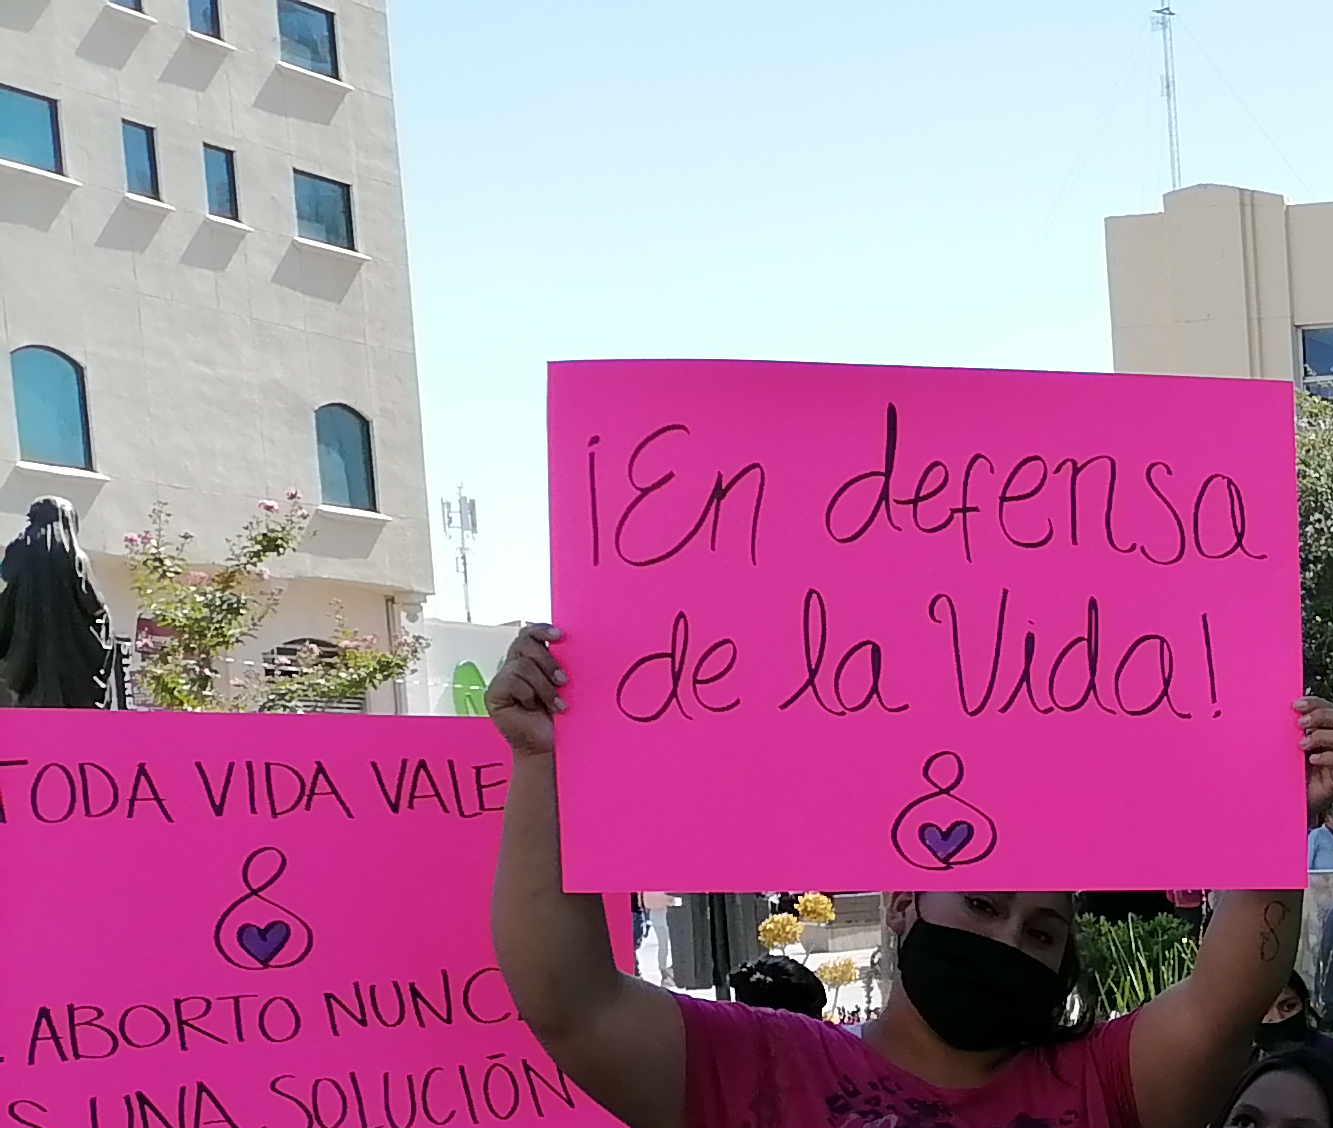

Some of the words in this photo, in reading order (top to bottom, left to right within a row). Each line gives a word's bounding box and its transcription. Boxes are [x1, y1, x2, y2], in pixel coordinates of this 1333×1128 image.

[589, 423, 766, 567] ¡En
[824, 401, 1268, 566] defensa
[616, 610, 741, 723] de
[778, 588, 910, 717] la
[928, 588, 1222, 720] Vida!
[195, 760, 354, 819] VIDA
[370, 760, 508, 819] VALE
[27, 995, 302, 1066] ABORTO
[323, 966, 523, 1037] NUNC
